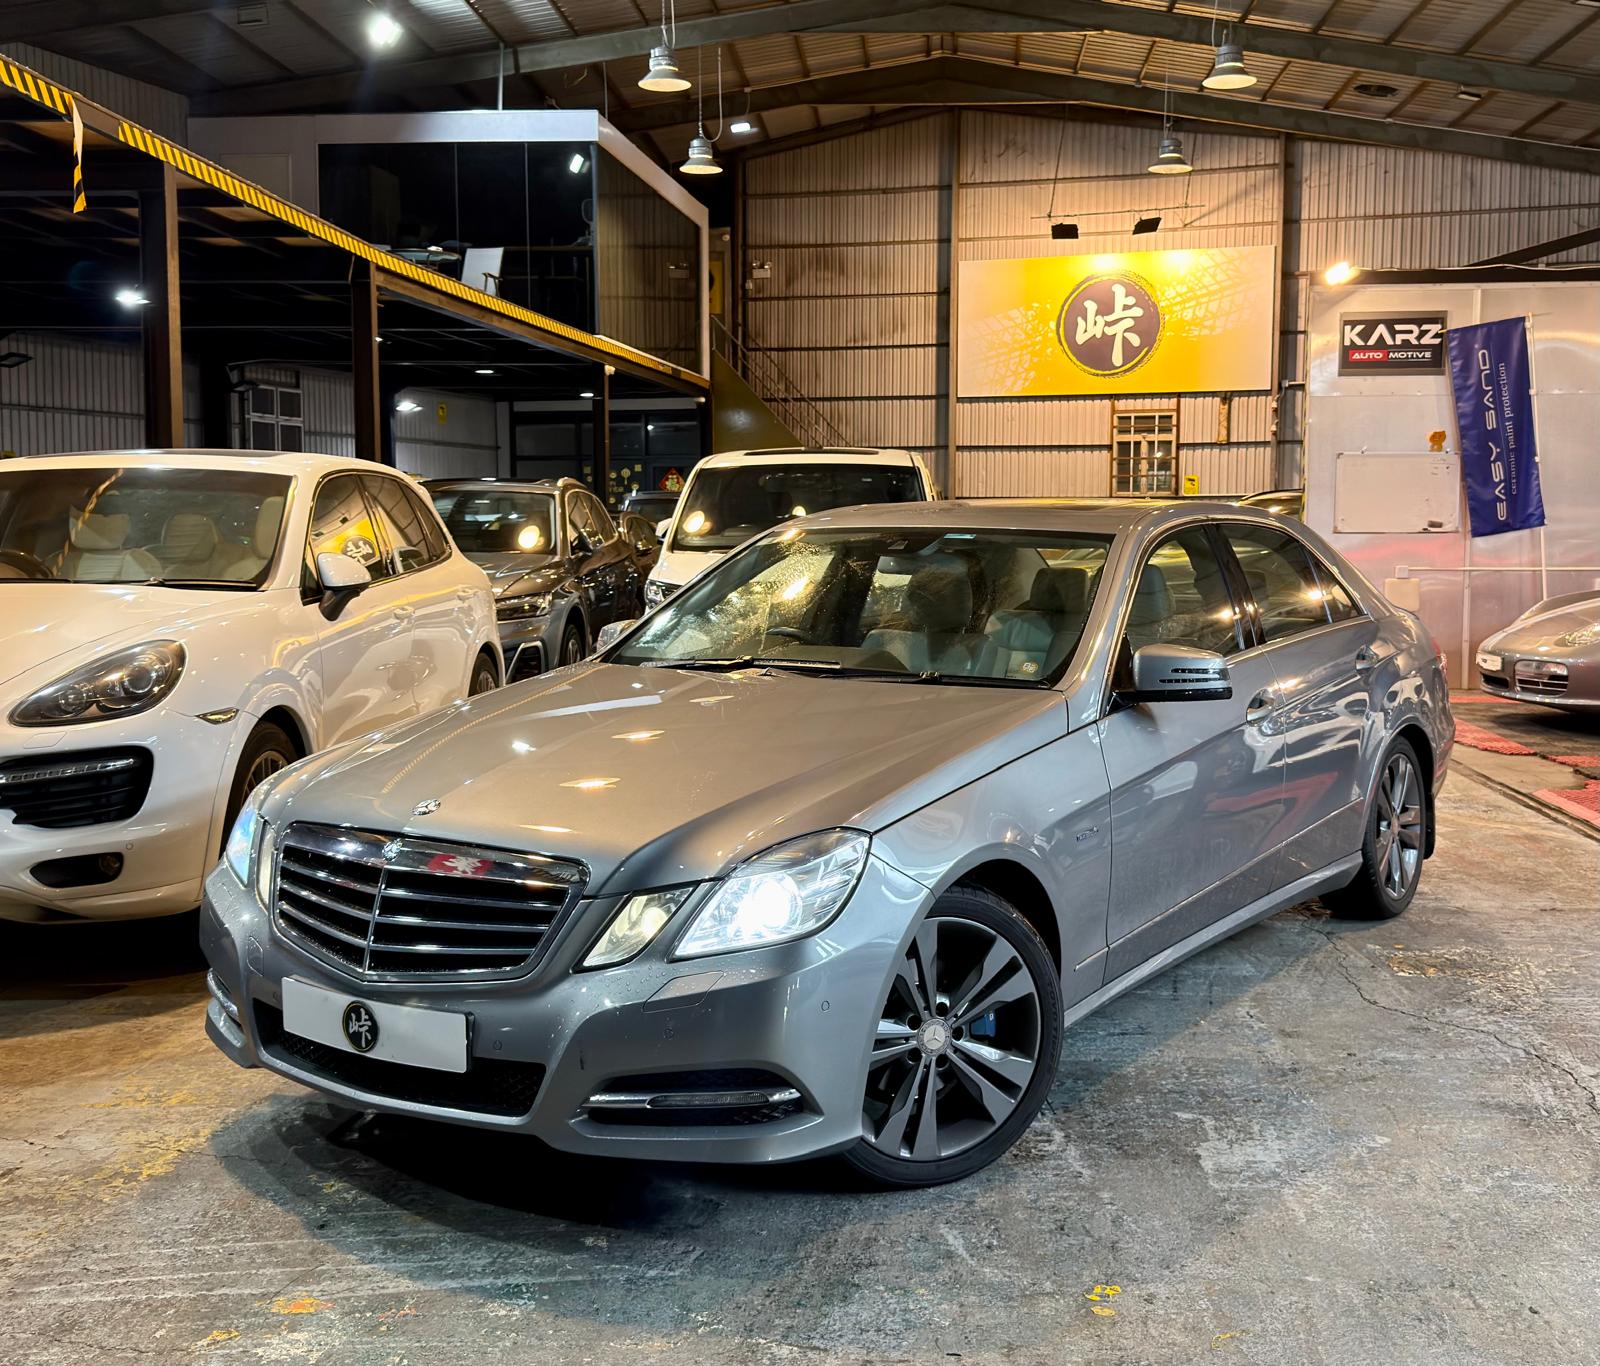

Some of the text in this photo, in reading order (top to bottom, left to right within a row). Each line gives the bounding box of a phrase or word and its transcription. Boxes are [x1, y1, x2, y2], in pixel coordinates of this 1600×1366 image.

[1075, 283, 1144, 367] 峠
[1343, 323, 1442, 346] KARZ
[1388, 351, 1433, 359] MOTIVE
[1478, 349, 1507, 520] EASY SAND
[1497, 362, 1517, 495] ceramic paint protection
[349, 1007, 371, 1048] 峠
